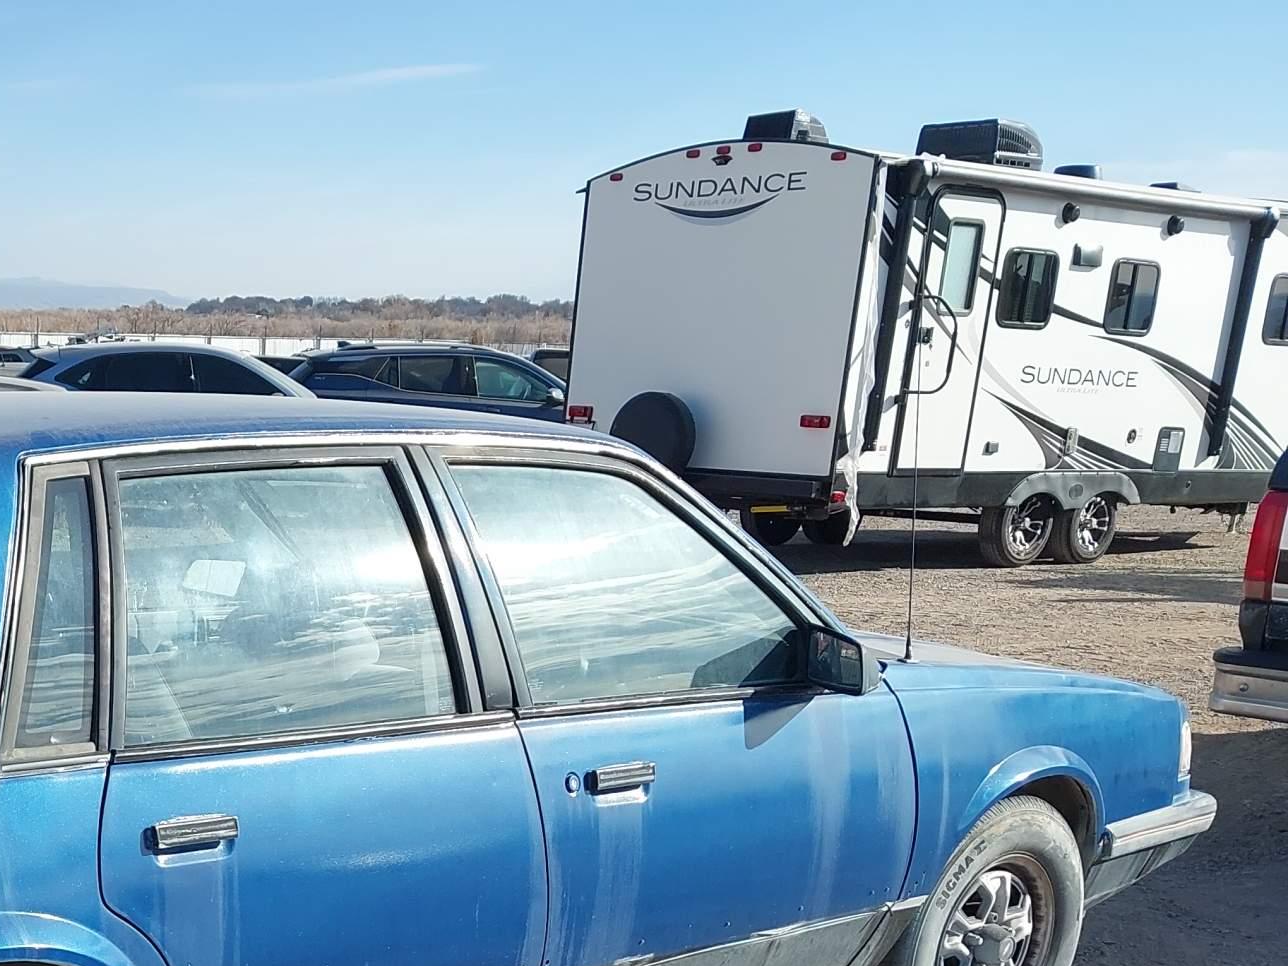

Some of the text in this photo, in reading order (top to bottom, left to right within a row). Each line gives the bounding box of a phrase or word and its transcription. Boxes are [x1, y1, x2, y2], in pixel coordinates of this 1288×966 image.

[633, 171, 808, 202] SUNDANCE
[1020, 365, 1139, 388] SUNDANCE
[935, 855, 975, 910] SIGMA
